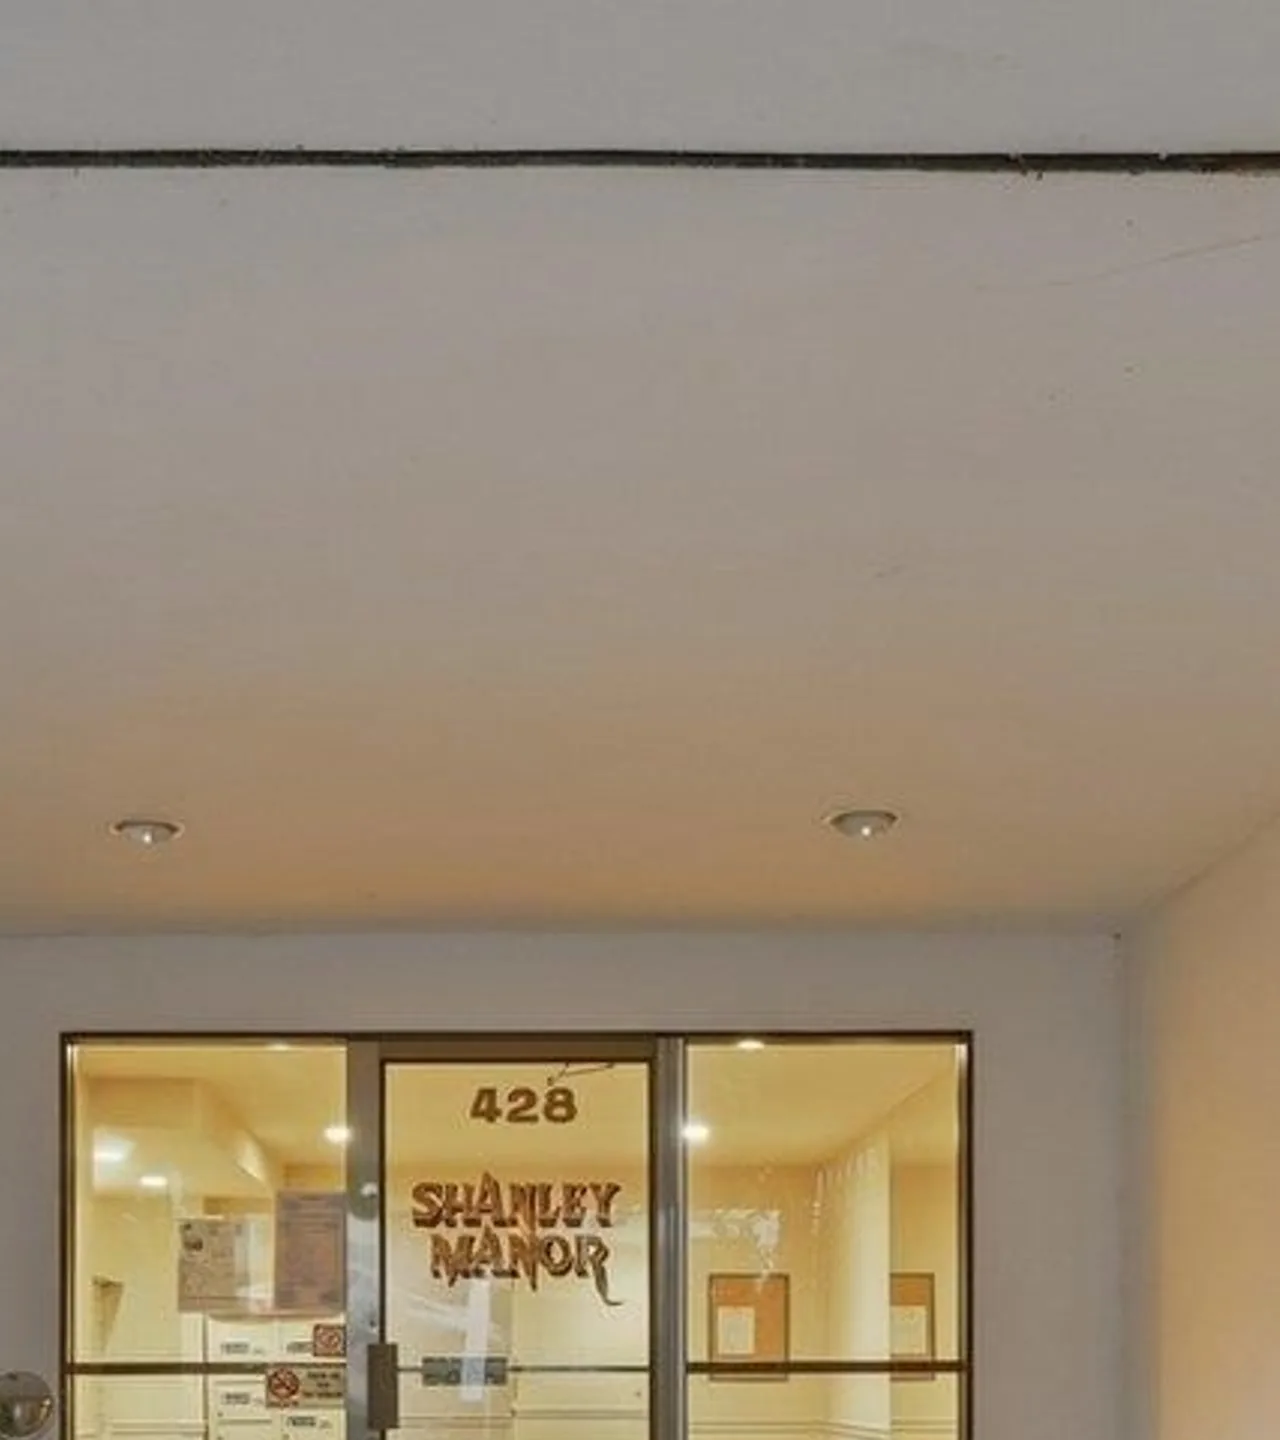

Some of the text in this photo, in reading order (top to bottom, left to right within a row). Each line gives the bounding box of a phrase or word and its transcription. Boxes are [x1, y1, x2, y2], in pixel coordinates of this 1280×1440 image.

[470, 1087, 578, 1124] 428
[412, 1171, 622, 1230] SHANLEY
[430, 1226, 623, 1306] MANOR
